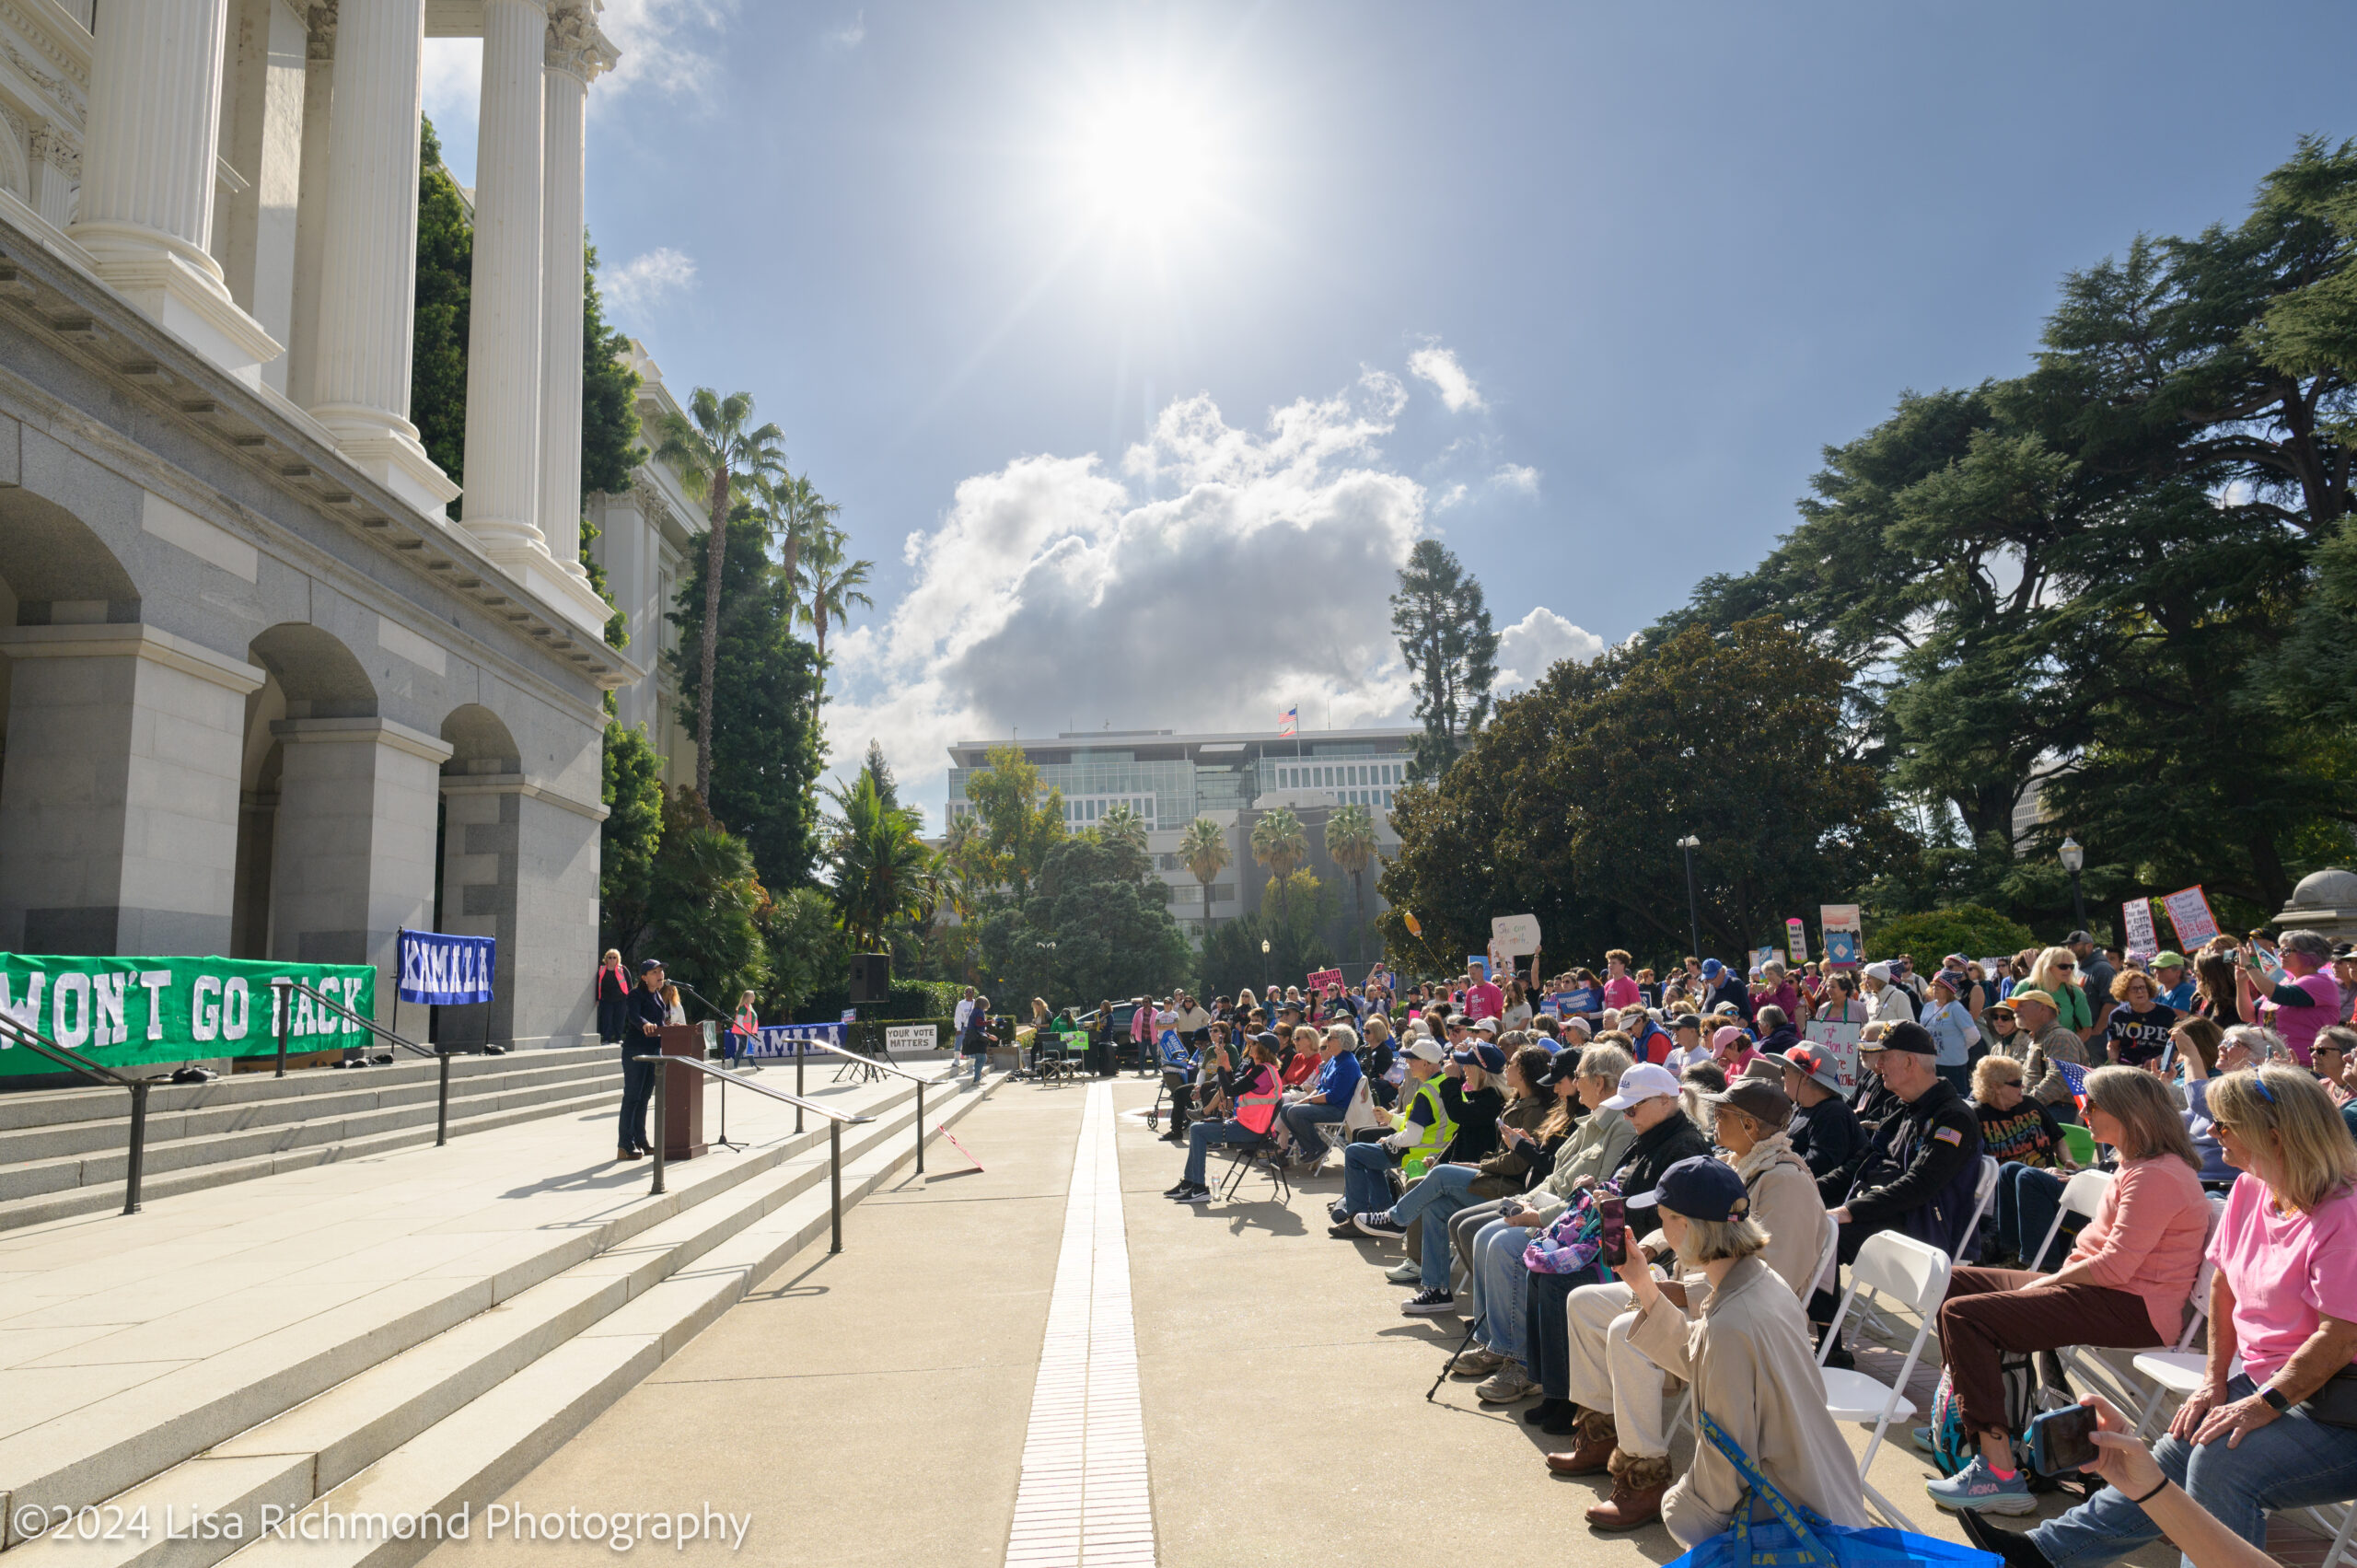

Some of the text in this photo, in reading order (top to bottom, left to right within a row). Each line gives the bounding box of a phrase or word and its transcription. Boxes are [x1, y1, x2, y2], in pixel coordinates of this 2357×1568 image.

[401, 939, 489, 993] KAMALA
[1309, 969, 1341, 981] EQUALITY
[1558, 992, 1591, 1004] REPRODUCTIVE
[0, 970, 362, 1050] WON'T GO BACK
[888, 1028, 935, 1038] YOUR VOTE
[2113, 1022, 2168, 1042] NOPE
[890, 1039, 929, 1048] MATTERS
[1846, 1041, 1853, 1054] is
[1968, 1483, 1999, 1495] HOKA
[1760, 1484, 1806, 1539] IKEA
[1752, 1553, 1777, 1565] EA
